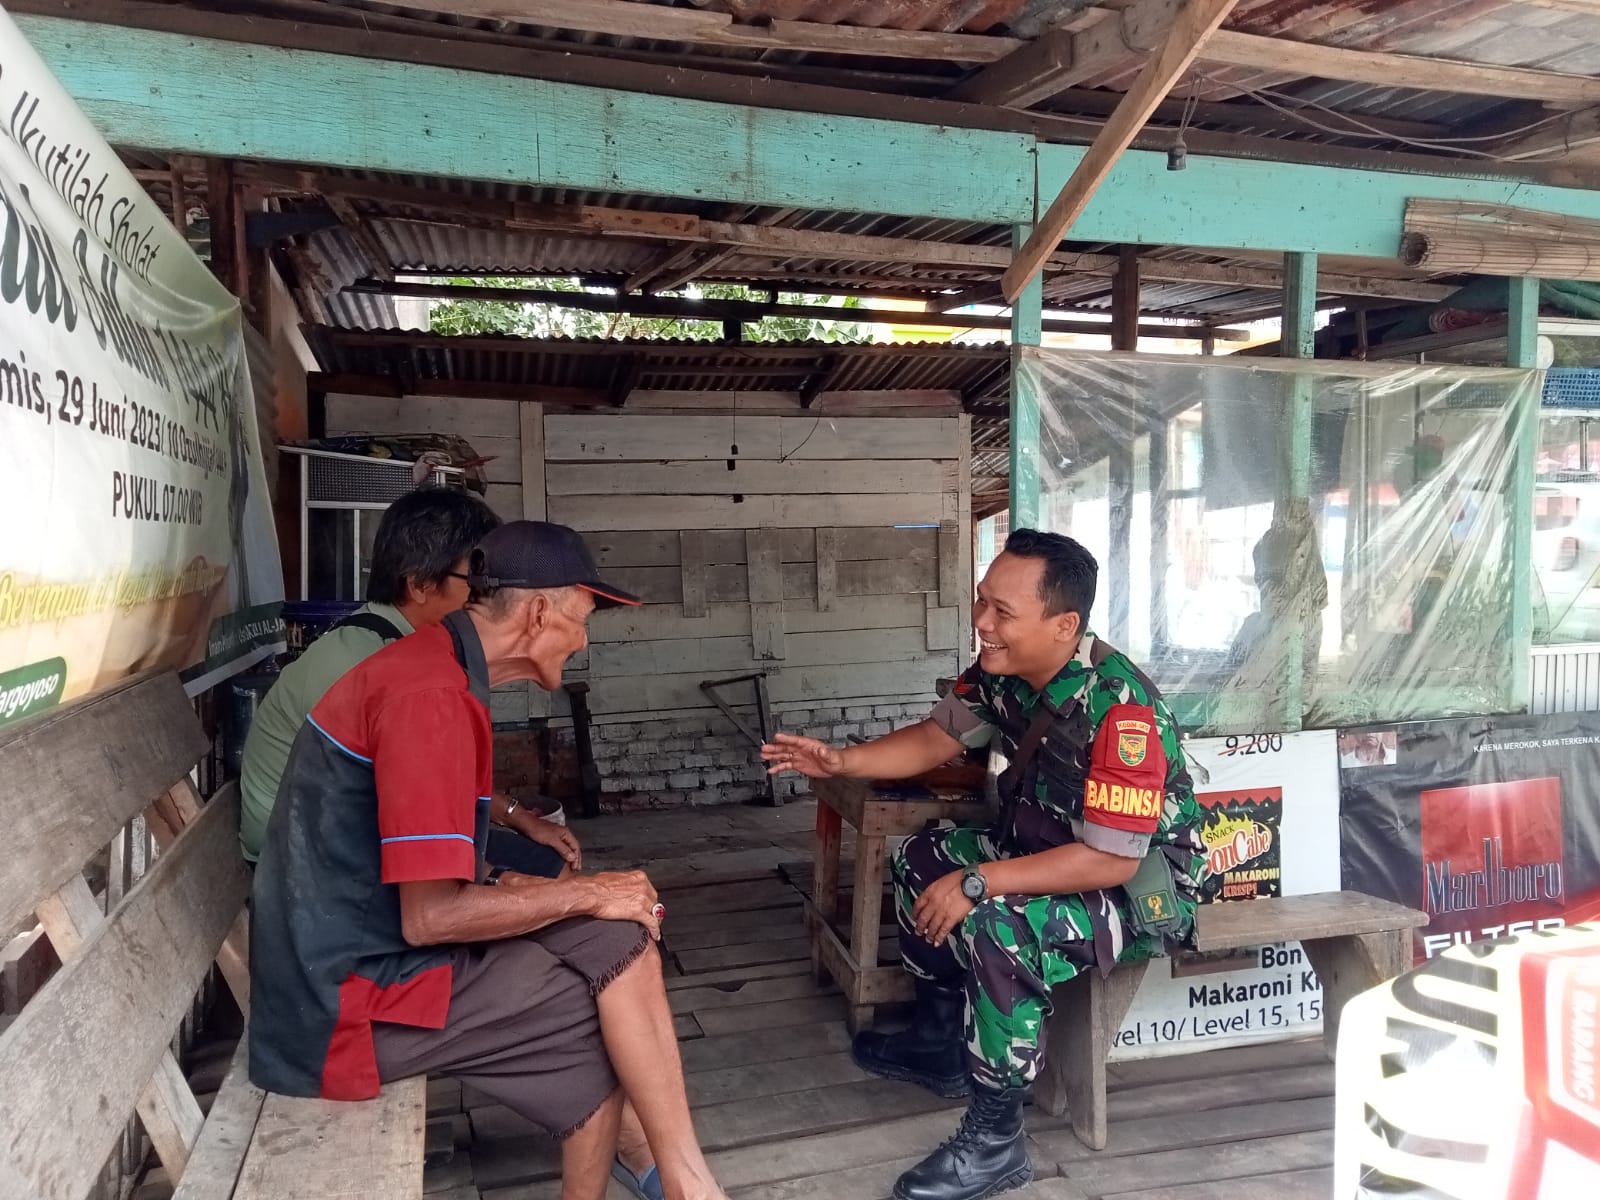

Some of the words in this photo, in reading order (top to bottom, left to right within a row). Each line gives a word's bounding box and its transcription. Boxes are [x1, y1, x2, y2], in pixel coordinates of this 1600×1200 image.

[104, 197, 160, 286] Sholat
[0, 350, 51, 425] mis,
[55, 369, 84, 426] 29
[90, 382, 127, 440] Juni
[113, 470, 160, 522] PUKUL
[162, 484, 189, 525] 07.00
[0, 672, 60, 718] argoyoso
[1225, 733, 1283, 756] 9.200
[1473, 744, 1503, 753] KARENA
[1542, 738, 1560, 747] SAYA
[1561, 736, 1593, 746] TERKENA
[1086, 780, 1163, 818] BABINSA
[1205, 824, 1235, 843] SNACK
[1224, 867, 1280, 885] MAKARONI
[1425, 836, 1562, 915] Marlboro
[1262, 946, 1302, 969] Bon
[1188, 974, 1292, 1008] Makaroni
[1112, 1022, 1142, 1048] vel
[1151, 1018, 1186, 1042] 10/
[1193, 1009, 1249, 1038] Level
[1258, 1005, 1290, 1029] 15,
